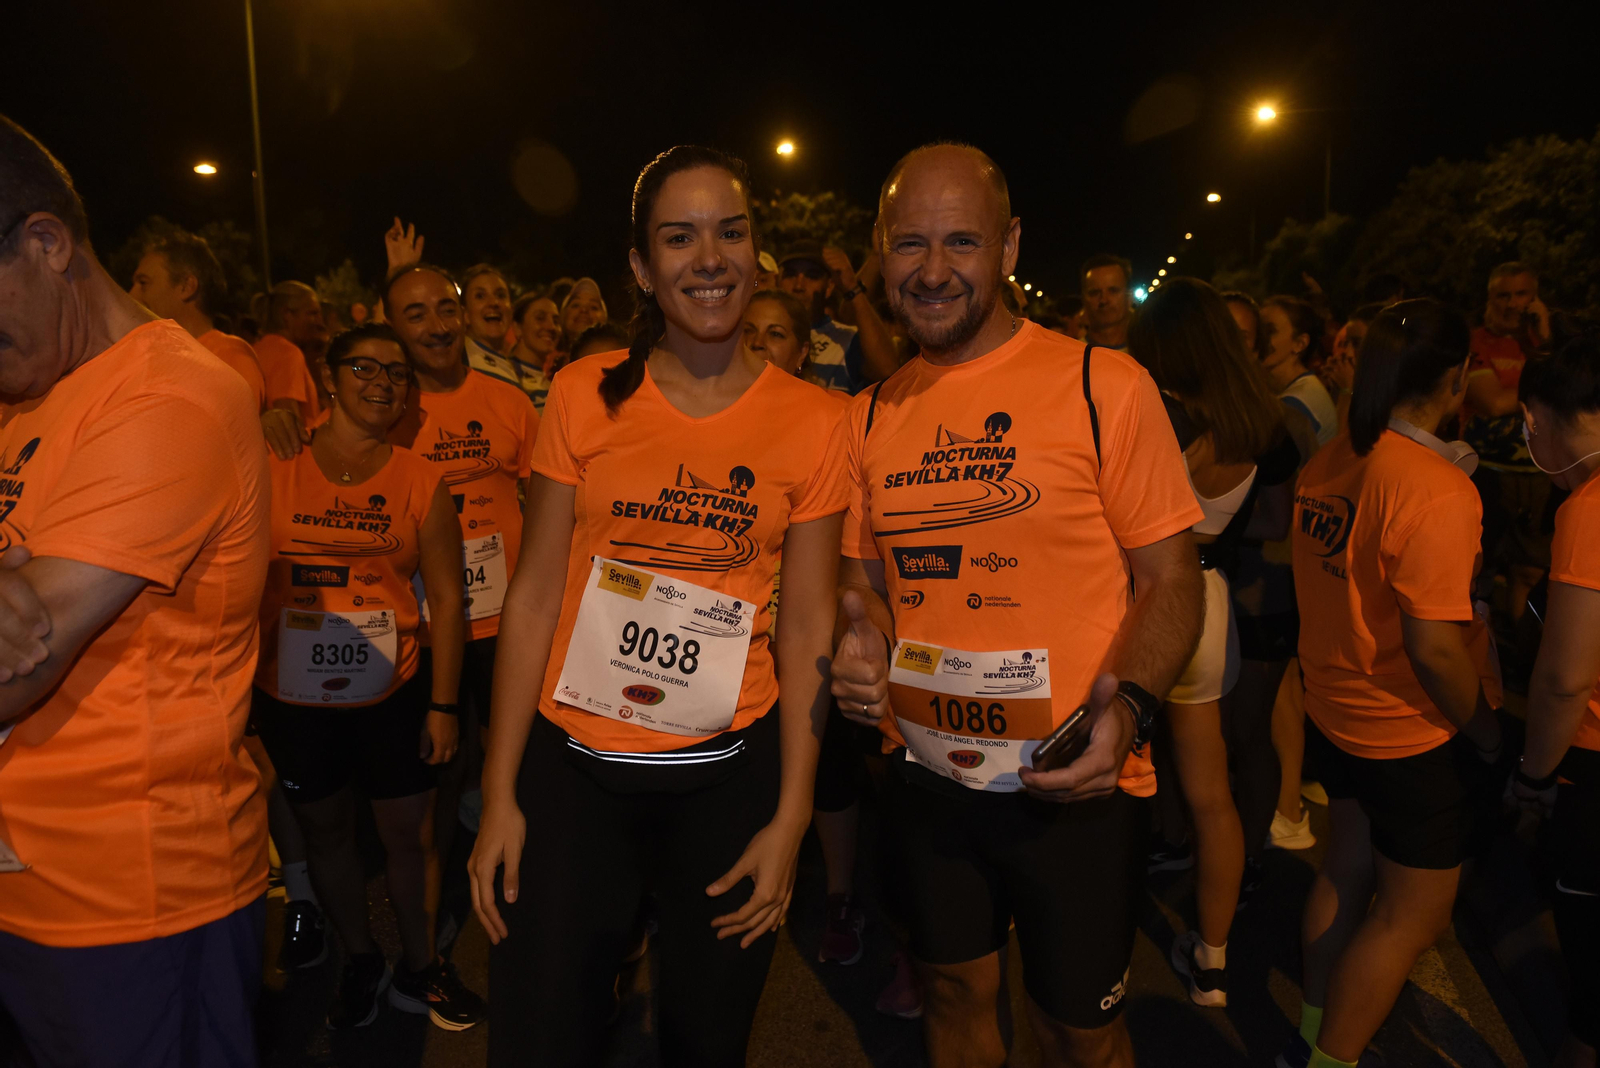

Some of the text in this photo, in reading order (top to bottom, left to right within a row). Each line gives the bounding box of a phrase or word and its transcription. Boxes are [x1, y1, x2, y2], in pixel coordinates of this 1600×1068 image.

[434, 439, 490, 451] NOCTURNA
[421, 450, 460, 462] VILLA
[921, 446, 1016, 466] NOCTURNA
[884, 467, 960, 489] SEVILLA
[611, 500, 700, 526] SEVILLA
[658, 487, 759, 519] NOCTURNA
[292, 513, 354, 529] SEVILLA
[324, 509, 391, 522] NOCTURNA
[463, 565, 486, 587] 04
[693, 608, 723, 622] SEVILLA
[710, 606, 742, 621] NOCTURNA
[312, 643, 368, 665] 8305
[619, 620, 701, 675] 9038
[610, 658, 689, 688] VERONICA POLO GUERRA
[999, 664, 1036, 672] NOCTURNA
[929, 695, 1007, 736] 1086
[940, 733, 953, 742] LUIS
[975, 739, 1009, 748] REDONDO
